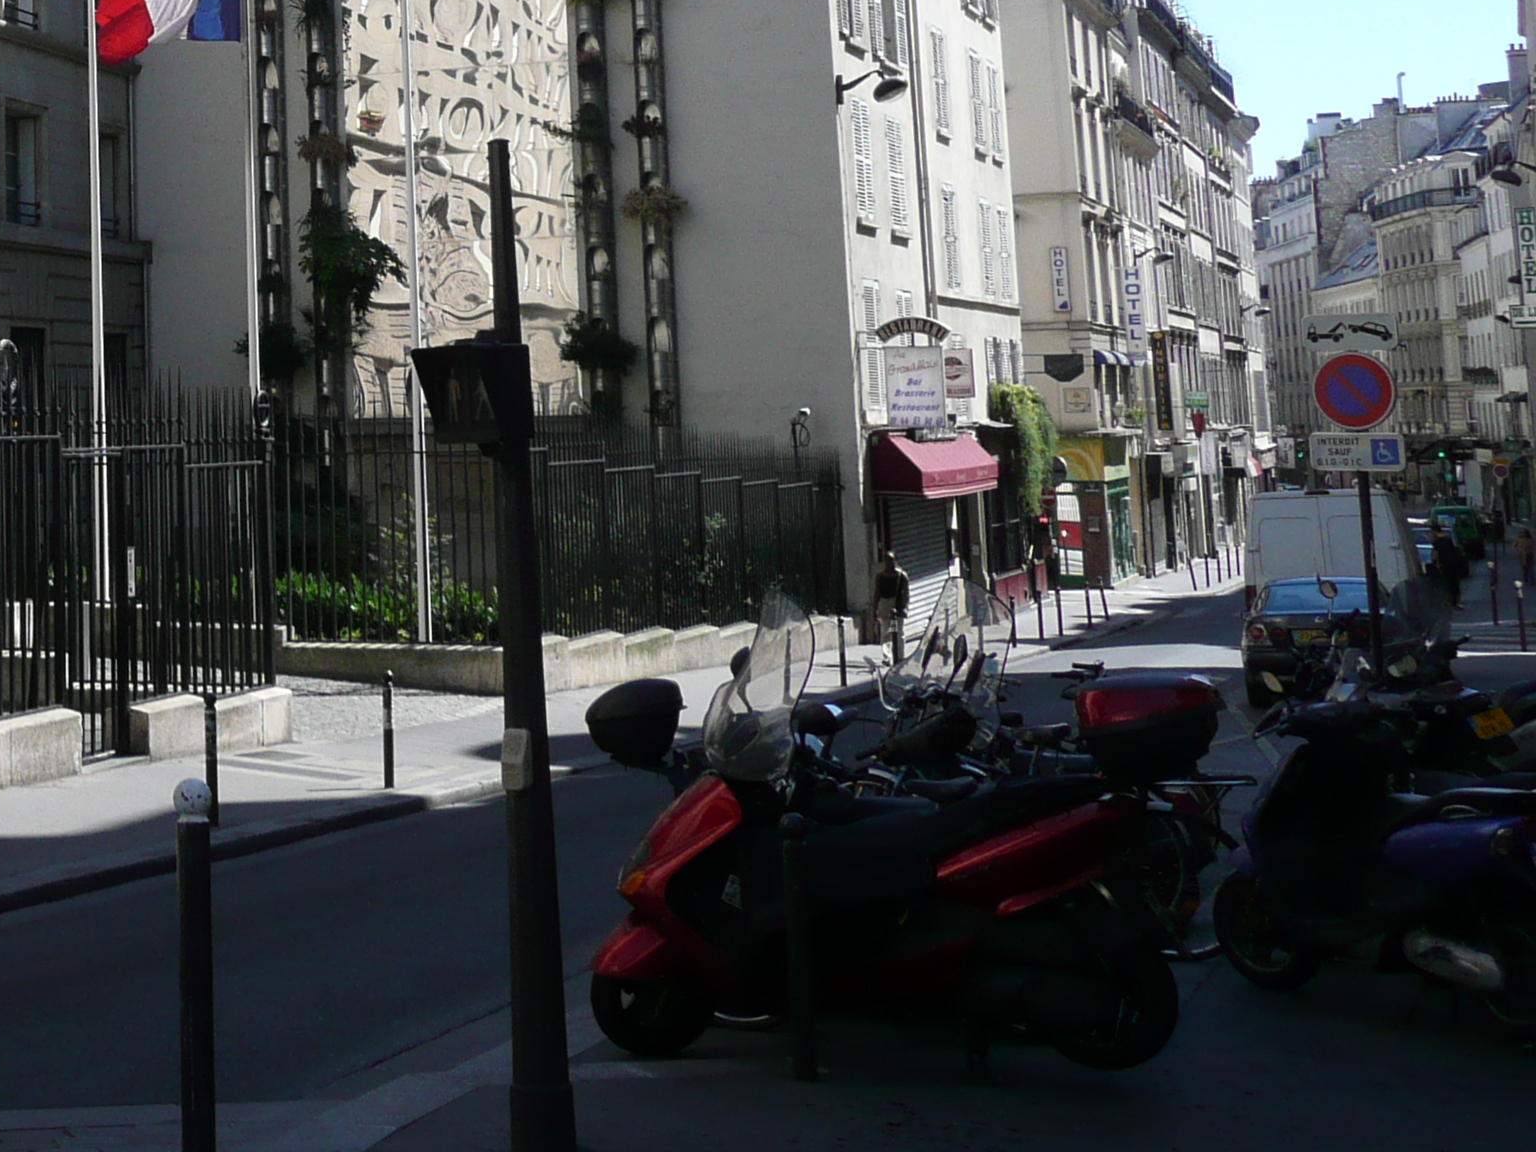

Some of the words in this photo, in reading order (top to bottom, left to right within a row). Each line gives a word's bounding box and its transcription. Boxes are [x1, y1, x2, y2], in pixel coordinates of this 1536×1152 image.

[1517, 209, 1536, 294] HOTEL
[1053, 250, 1065, 297] HOTEL
[1125, 269, 1142, 341] HOTEL
[878, 318, 946, 339] RESTAURANT
[907, 378, 922, 386] Bar
[894, 389, 936, 397] Brasserie
[890, 403, 940, 411] Restaurant
[1317, 437, 1360, 446] INTERDIT
[1328, 448, 1352, 456] SAUF
